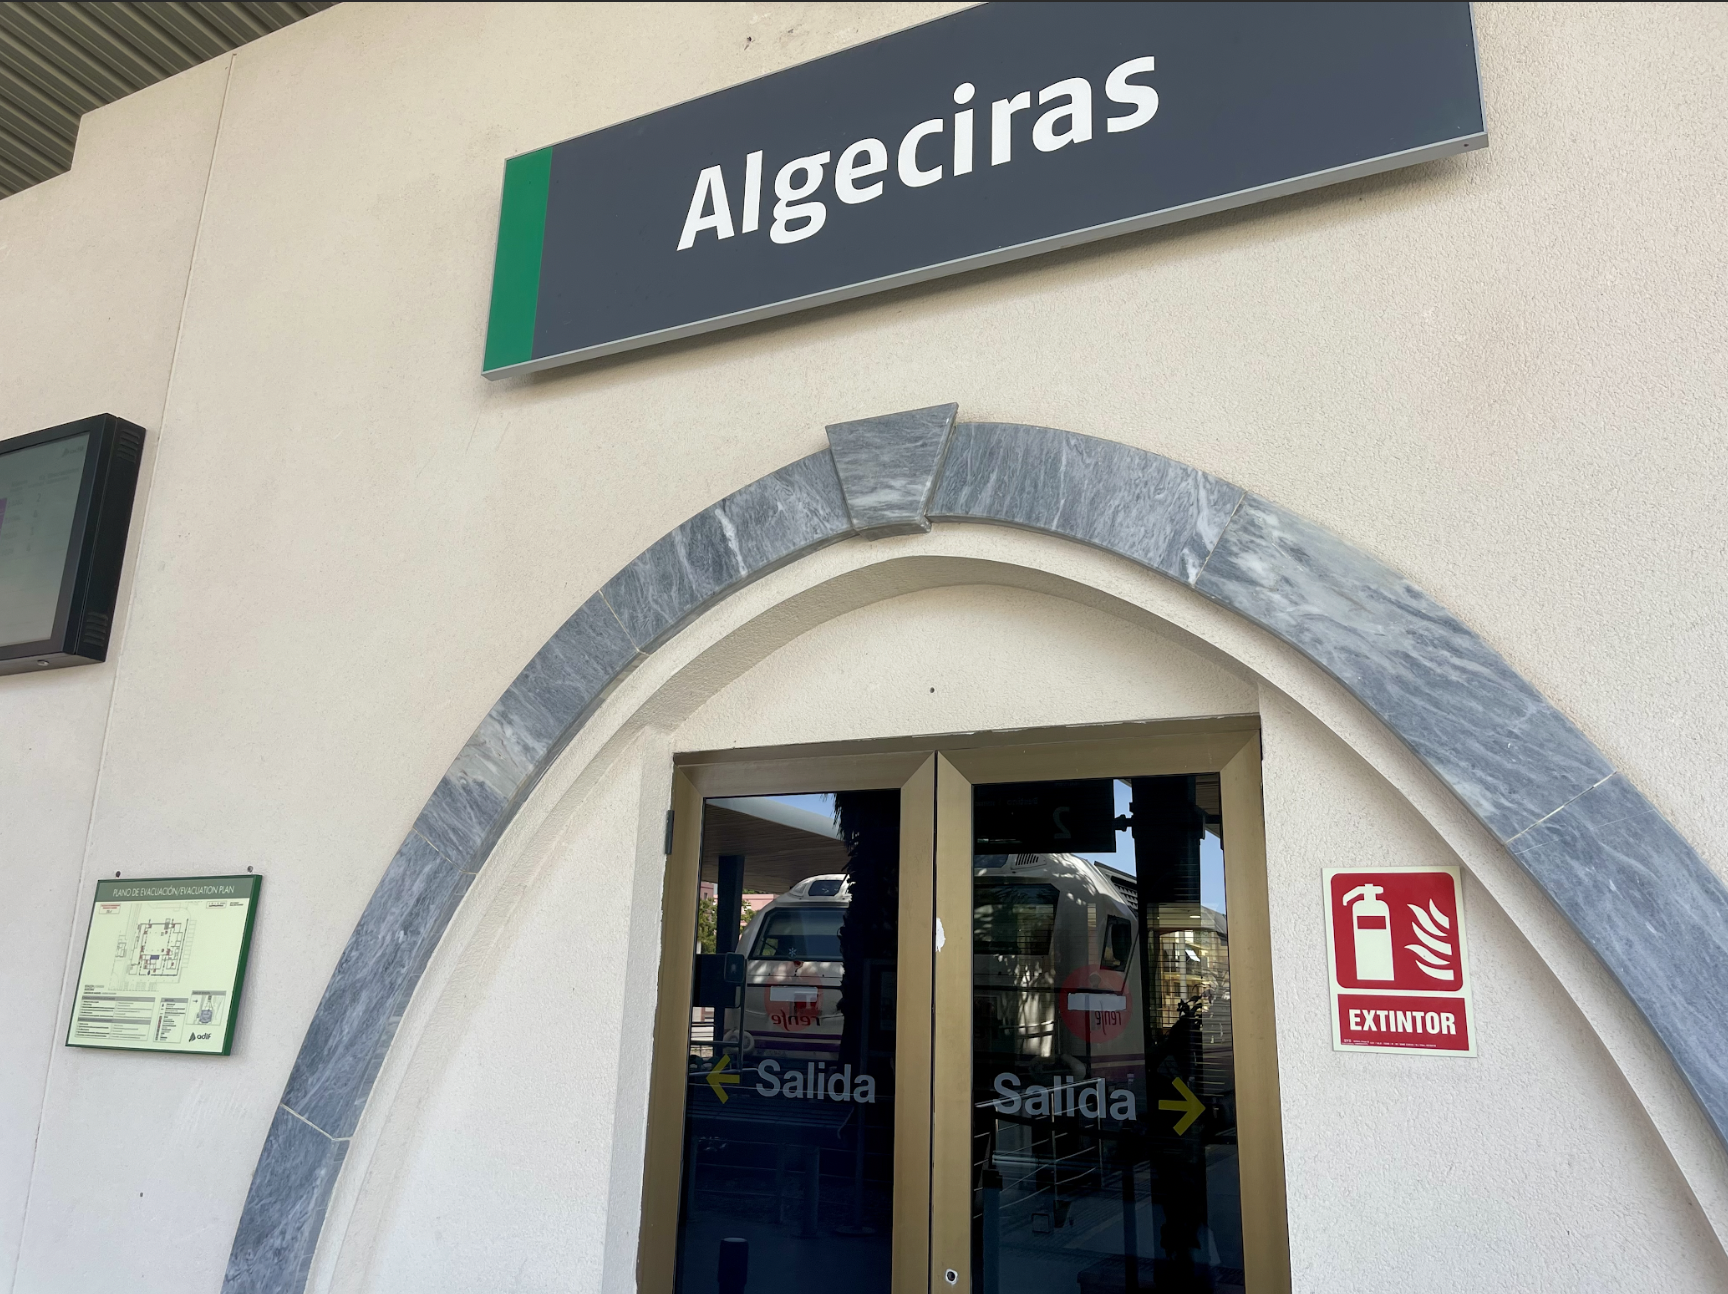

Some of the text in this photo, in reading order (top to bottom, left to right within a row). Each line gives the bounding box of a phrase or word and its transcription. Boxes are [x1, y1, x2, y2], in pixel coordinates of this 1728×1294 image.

[677, 55, 1160, 252] Algeciras
[112, 887, 131, 897] PLANO
[131, 887, 141, 896] DE
[219, 885, 235, 894] PLAN
[196, 1032, 211, 1040] adif
[1349, 1009, 1456, 1035] EXTINTOR
[755, 1058, 876, 1104] Salida
[993, 1072, 1137, 1121] Salida
